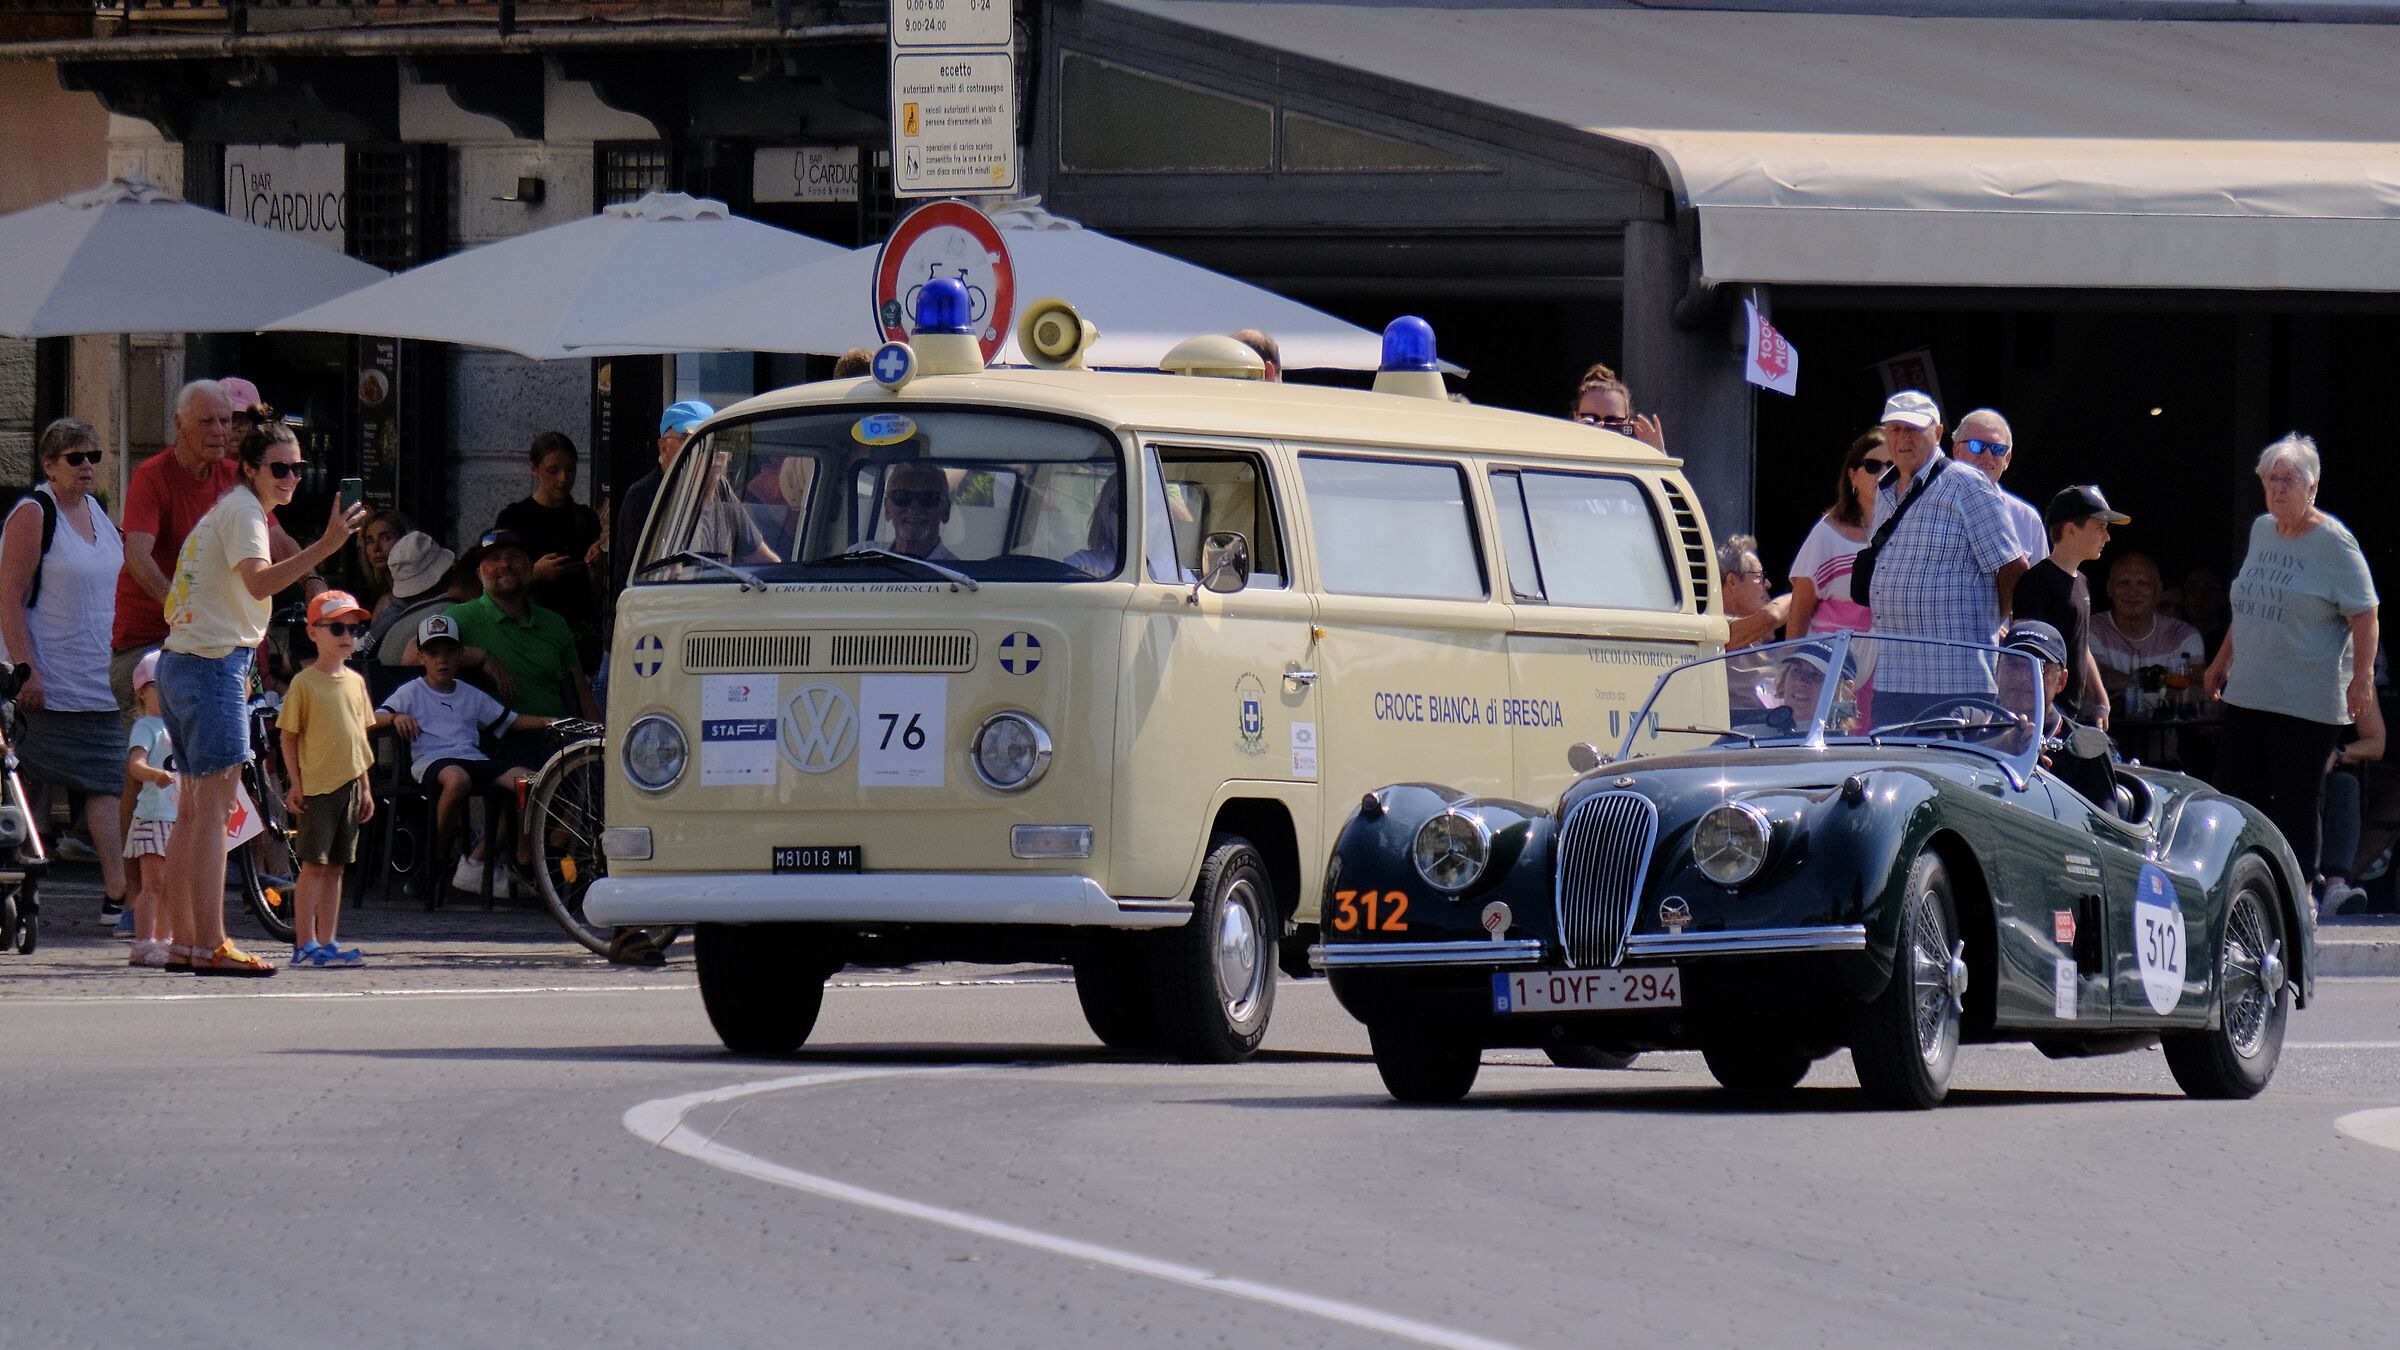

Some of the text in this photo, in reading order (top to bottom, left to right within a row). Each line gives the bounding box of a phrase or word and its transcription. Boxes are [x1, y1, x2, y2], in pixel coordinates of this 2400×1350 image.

[940, 63, 972, 77] eccetto
[903, 83, 1004, 95] autorizzati muniti di contrassegno
[925, 105, 942, 114] veicoli
[944, 104, 970, 114] autorizzati
[978, 104, 997, 113] servizio
[925, 116, 993, 128] persone diversamente abili
[926, 142, 993, 152] operazioni di carico scarico
[926, 155, 953, 164] consentito
[962, 154, 967, 163] le
[968, 155, 977, 163] ore
[987, 154, 992, 163] le
[926, 165, 991, 176] con disco orario 15 minuti
[251, 172, 272, 192] BAR
[2259, 550, 2305, 573] ALWAYS
[2246, 567, 2264, 580] ON
[775, 584, 940, 593] CROCE BIANCA DI BRESCIA
[1588, 647, 1631, 665] VEICOLO
[1631, 650, 1673, 668] STORICO
[1374, 692, 1564, 728] CROCE BIANCA di BRESCIA
[878, 713, 926, 751] 76
[776, 850, 830, 867] M81018
[1334, 889, 1410, 932] 312
[2145, 918, 2178, 973] 312
[1498, 997, 1509, 1010] B
